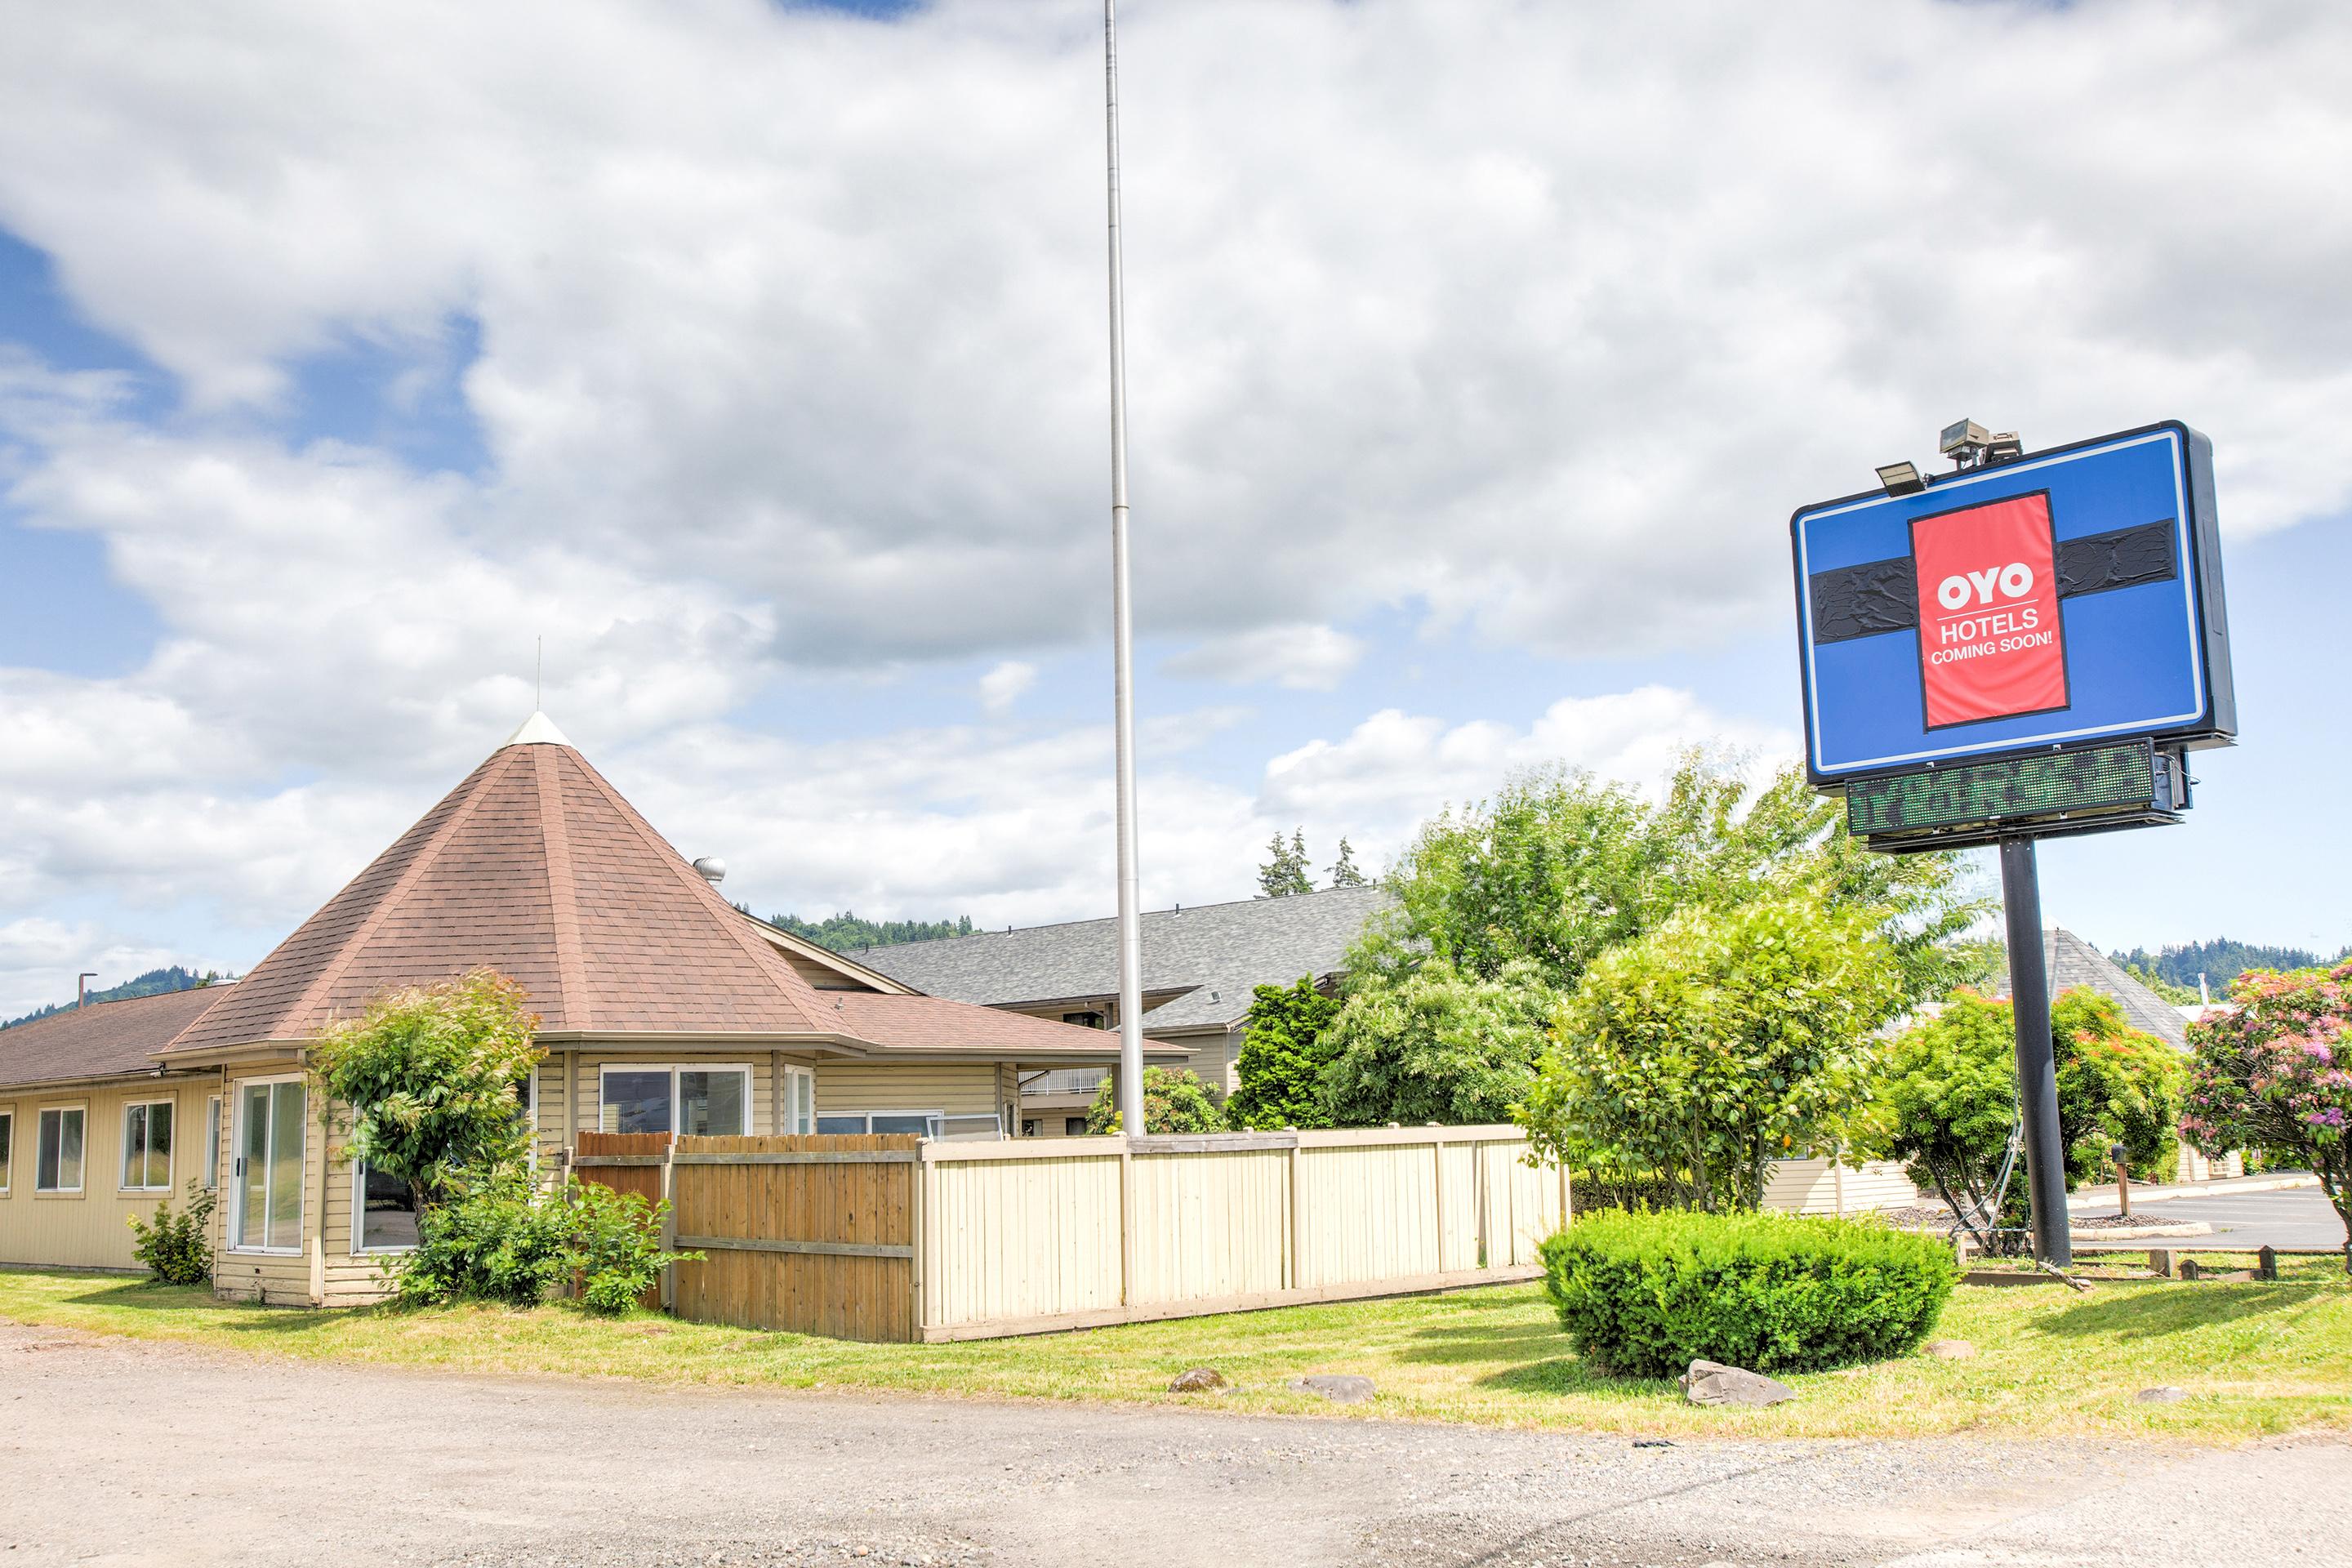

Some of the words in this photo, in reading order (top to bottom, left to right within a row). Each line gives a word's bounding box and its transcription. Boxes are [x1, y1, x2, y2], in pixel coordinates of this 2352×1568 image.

[1937, 562, 2034, 610] OYO
[1940, 608, 2038, 644] HOTELS
[1931, 642, 1996, 665] COMING
[2000, 630, 2052, 652] SOON!
